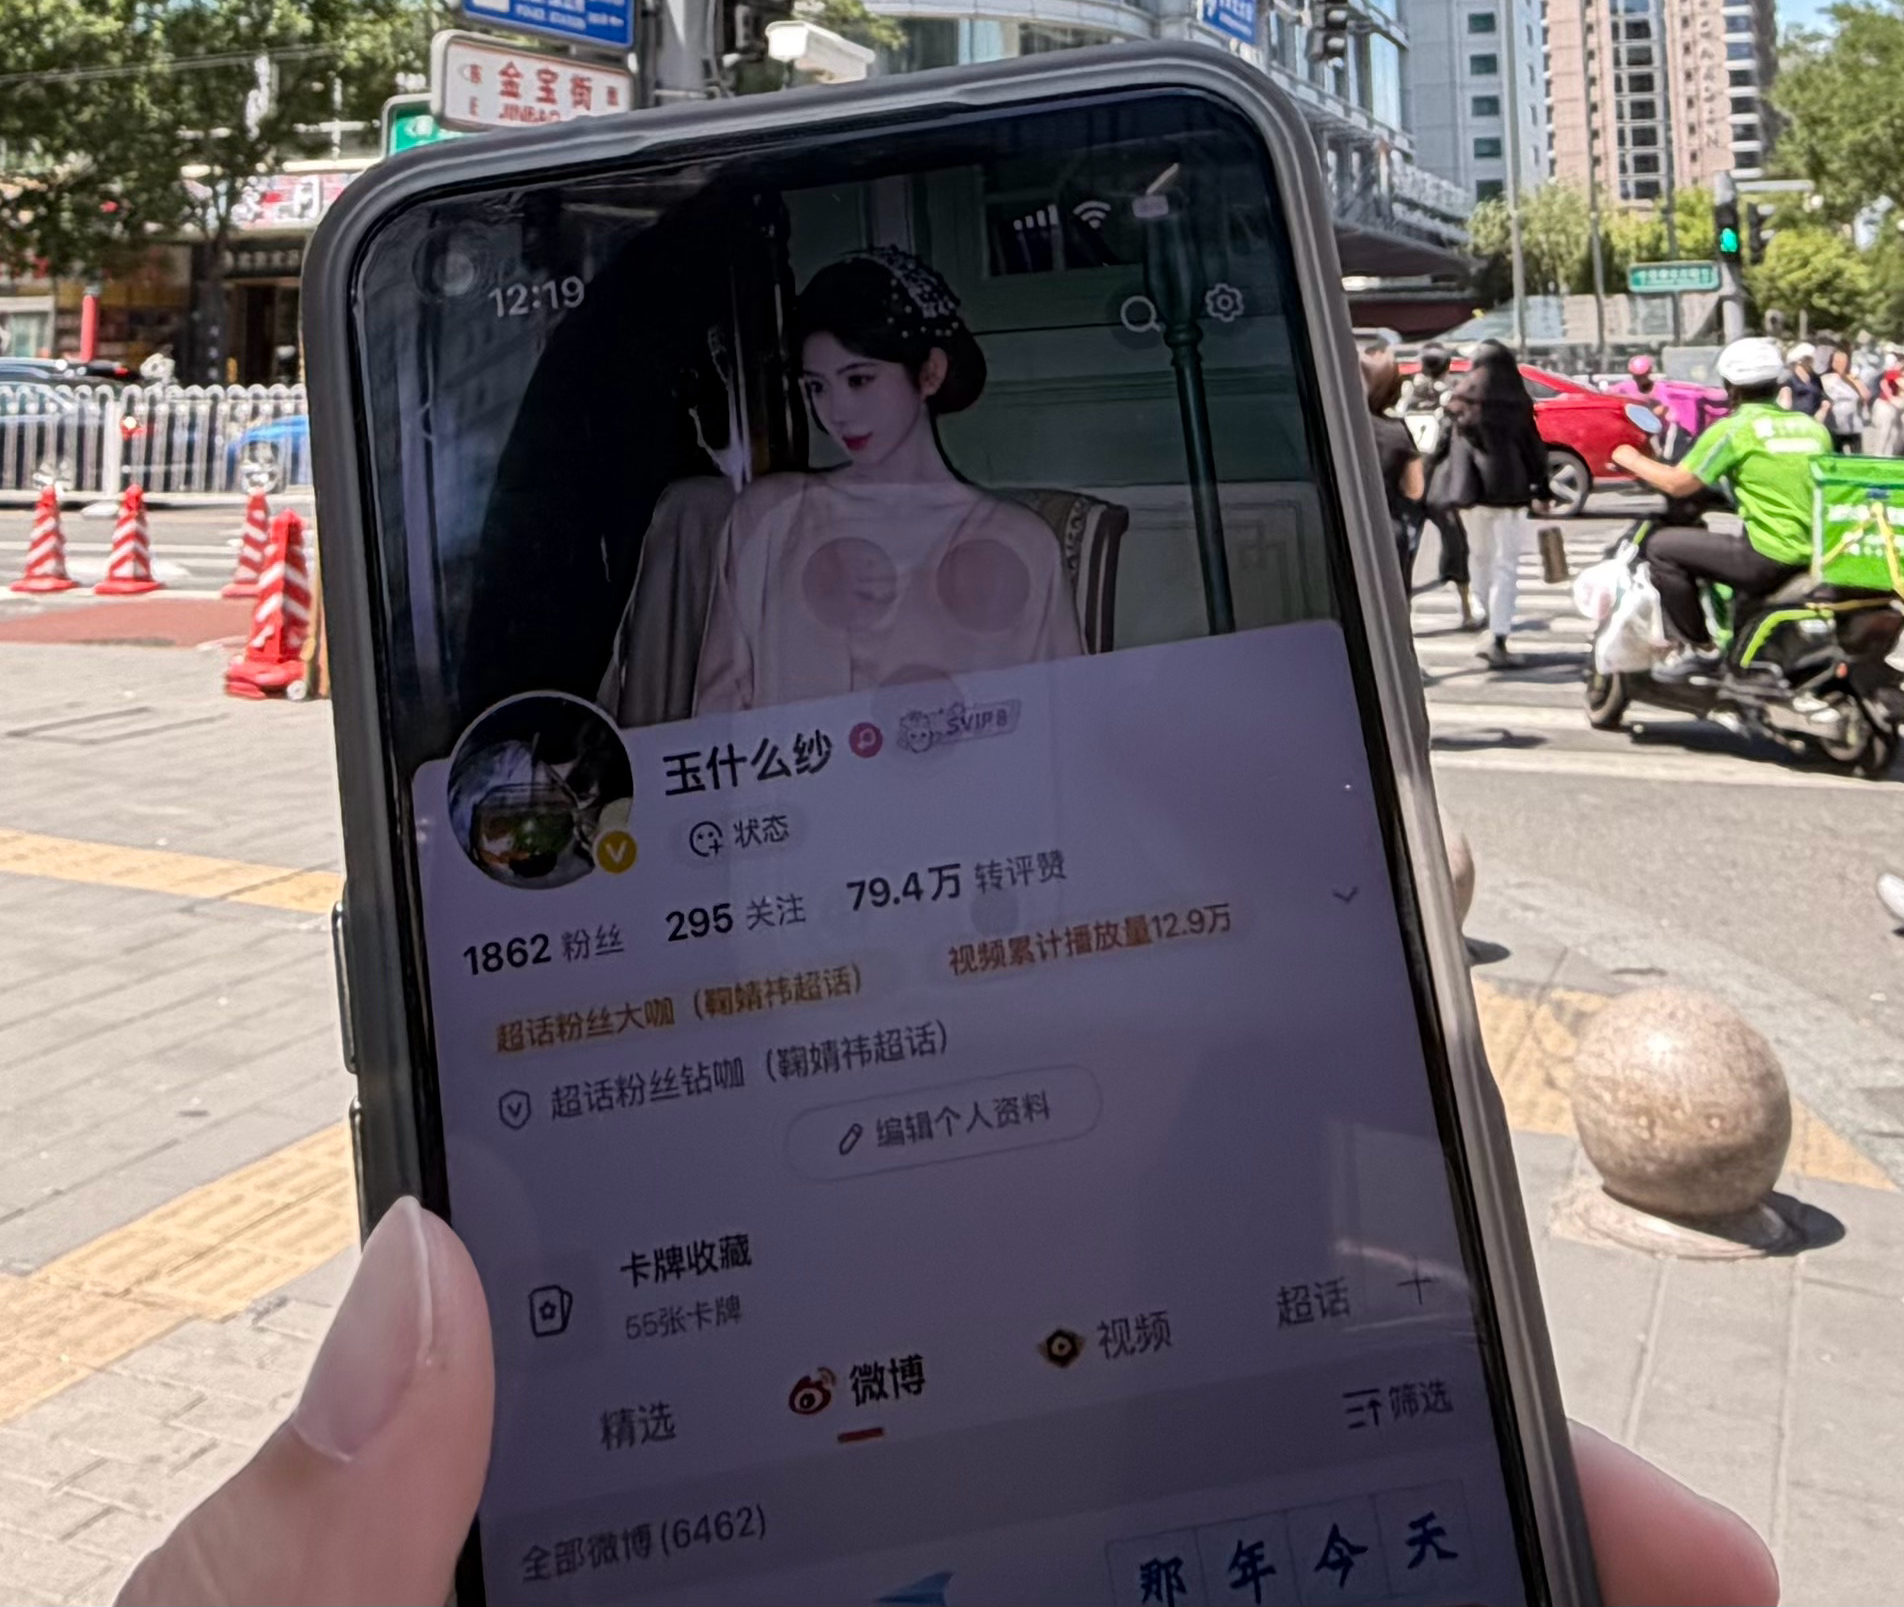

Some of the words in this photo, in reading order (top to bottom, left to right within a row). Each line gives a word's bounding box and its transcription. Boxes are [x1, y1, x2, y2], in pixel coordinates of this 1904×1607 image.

[498, 61, 593, 110] 金宝街
[488, 276, 585, 318] 12:19
[662, 728, 833, 796] 玉什么纱
[732, 814, 790, 850] 状态
[462, 933, 552, 976] 1862
[561, 923, 625, 961] 粉丝
[666, 903, 734, 941] 295
[746, 894, 806, 930] 关注
[847, 863, 962, 911] 79.4万
[974, 850, 1067, 893] 转评赞
[948, 903, 1231, 976] 视频累计播放量12.9万
[876, 1091, 1050, 1148] 编辑个人资料
[620, 1233, 752, 1288] 卡牌收藏
[625, 1295, 743, 1340] 55张卡牌
[600, 1402, 676, 1450] 精选
[850, 1354, 926, 1407] 微博
[1098, 1310, 1173, 1359] 视频
[1277, 1277, 1351, 1328] 超话
[1388, 1380, 1453, 1419] 筛选
[1139, 1510, 1459, 1607] 那年今天
